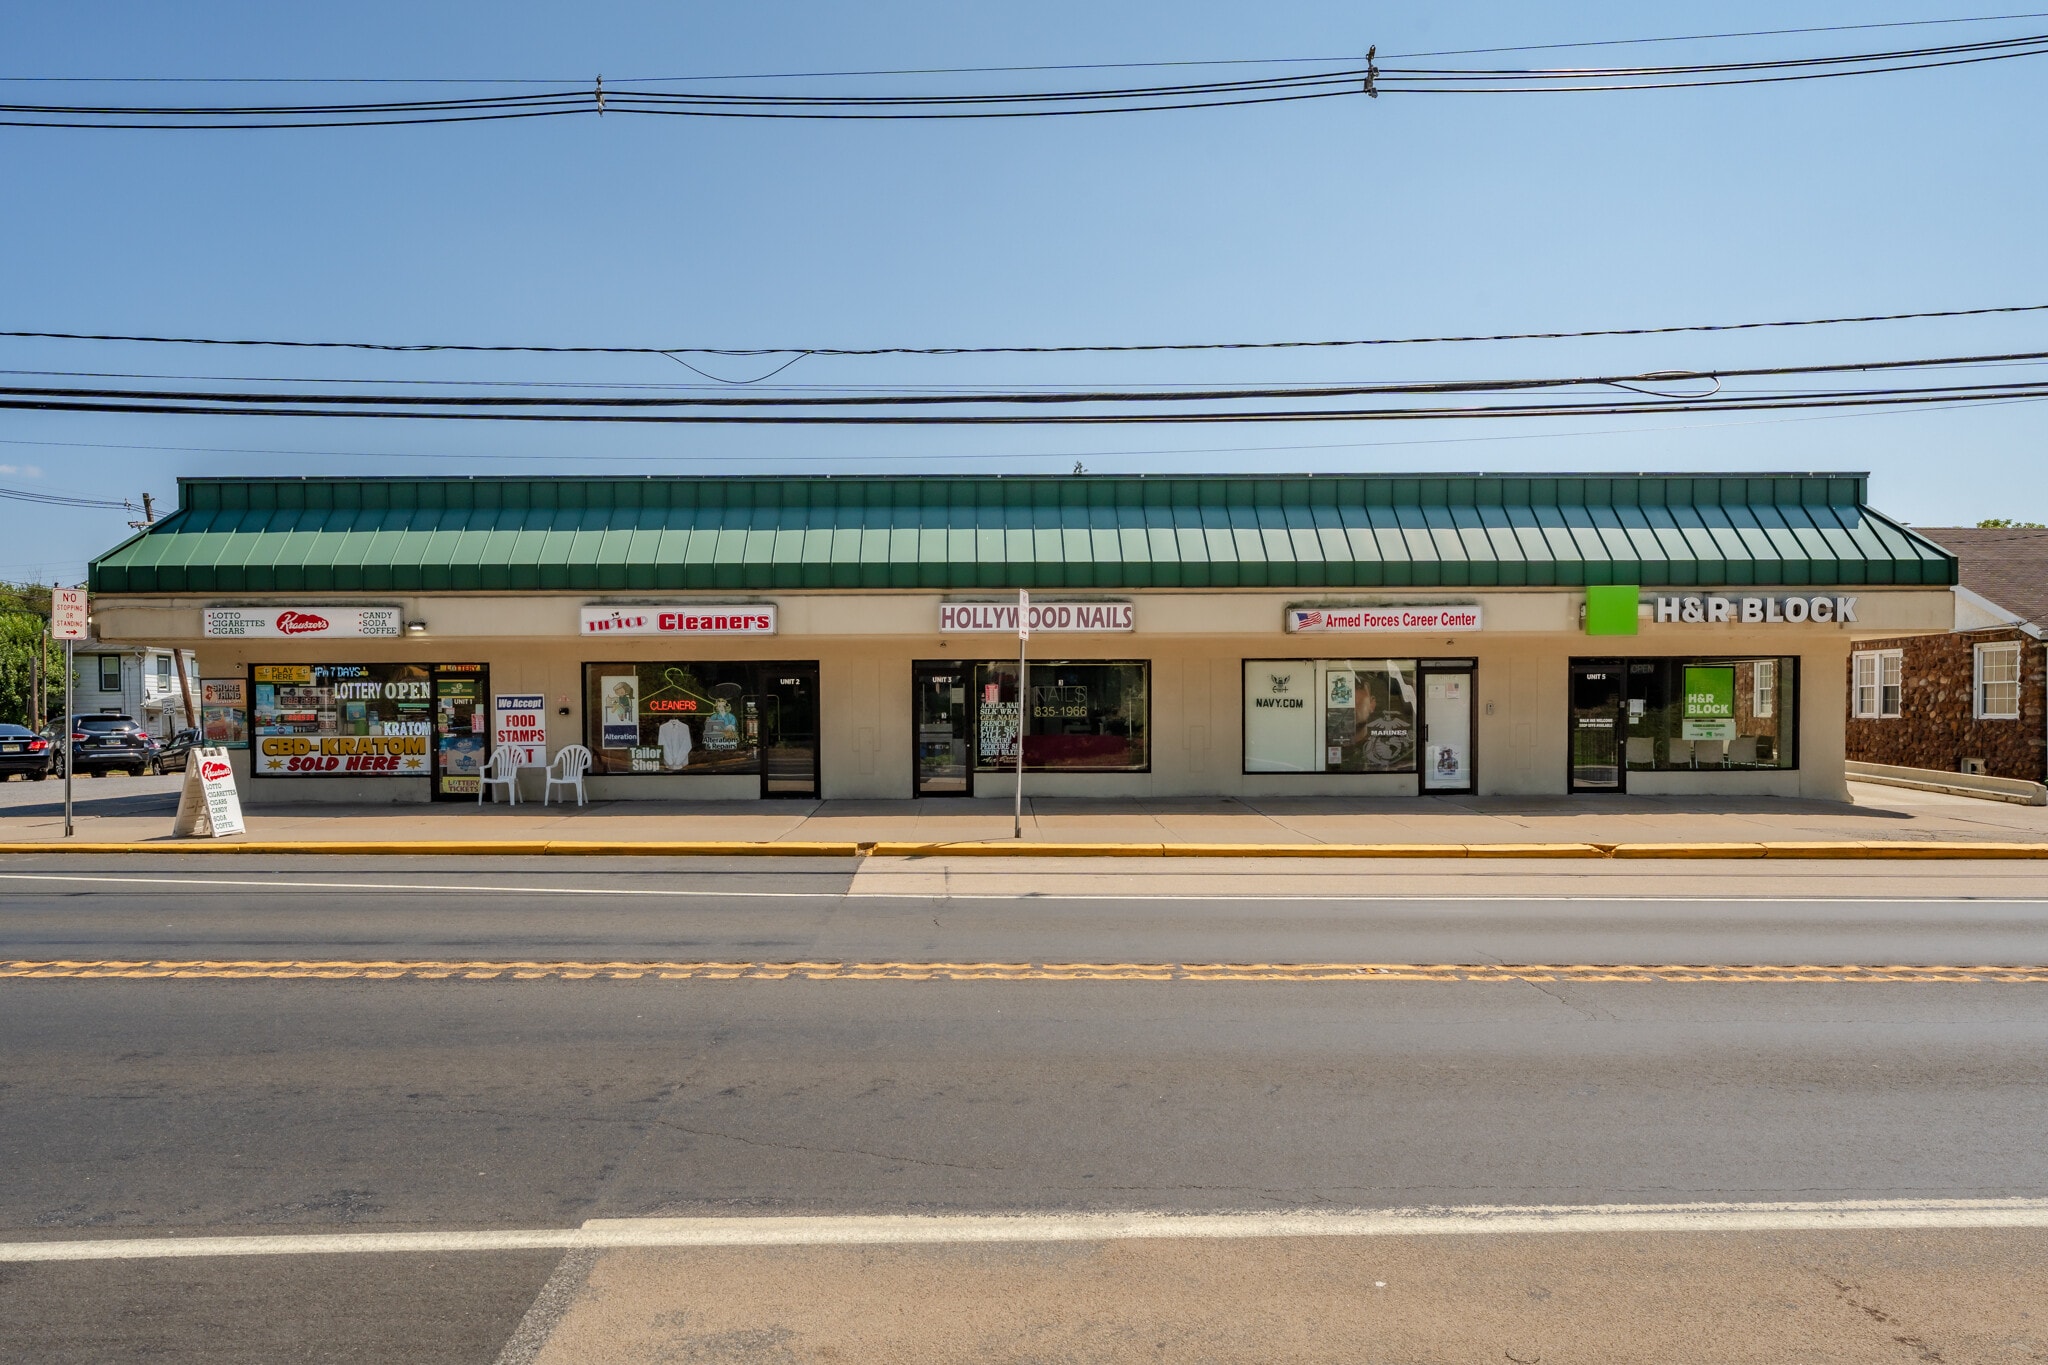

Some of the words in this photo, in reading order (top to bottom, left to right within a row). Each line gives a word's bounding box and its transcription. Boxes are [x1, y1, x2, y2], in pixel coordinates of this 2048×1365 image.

[63, 593, 77, 602] NO
[1657, 597, 1730, 623] H&R
[1741, 597, 1859, 623] BLOCK
[658, 612, 771, 631] Cleaners
[941, 607, 1071, 629] HOLLYWOOD
[1076, 607, 1132, 628] NAILS
[1326, 613, 1361, 628] Armed
[1364, 613, 1400, 627] Forces
[1402, 612, 1438, 627] Career
[1441, 612, 1476, 626] Center
[337, 667, 361, 677] DAYS
[445, 664, 478, 672] LOTTERY
[1631, 664, 1655, 673] OPEN
[214, 684, 241, 692] SHORE
[335, 682, 382, 699] LOTTERY
[385, 682, 431, 699] OPEN
[218, 692, 242, 700] THING
[1688, 693, 1715, 703] H&R
[498, 699, 511, 708] We
[512, 699, 542, 708] Accept
[650, 700, 697, 710] CLEANERS
[1256, 698, 1304, 708] NAVY.COM
[1034, 706, 1087, 717] 835-1966
[1688, 704, 1729, 714] BLOCK
[506, 714, 536, 727] FOOD
[384, 721, 432, 735] KRATOM
[497, 729, 545, 743] STAMPS
[262, 737, 427, 756] CBD-KRATOM
[630, 747, 662, 759] Tailor
[287, 757, 340, 771] SOLD
[345, 756, 402, 771] HERE
[632, 760, 660, 772] Shop
[208, 789, 237, 798] CIGARETTES
[215, 822, 234, 830] COFFEE
